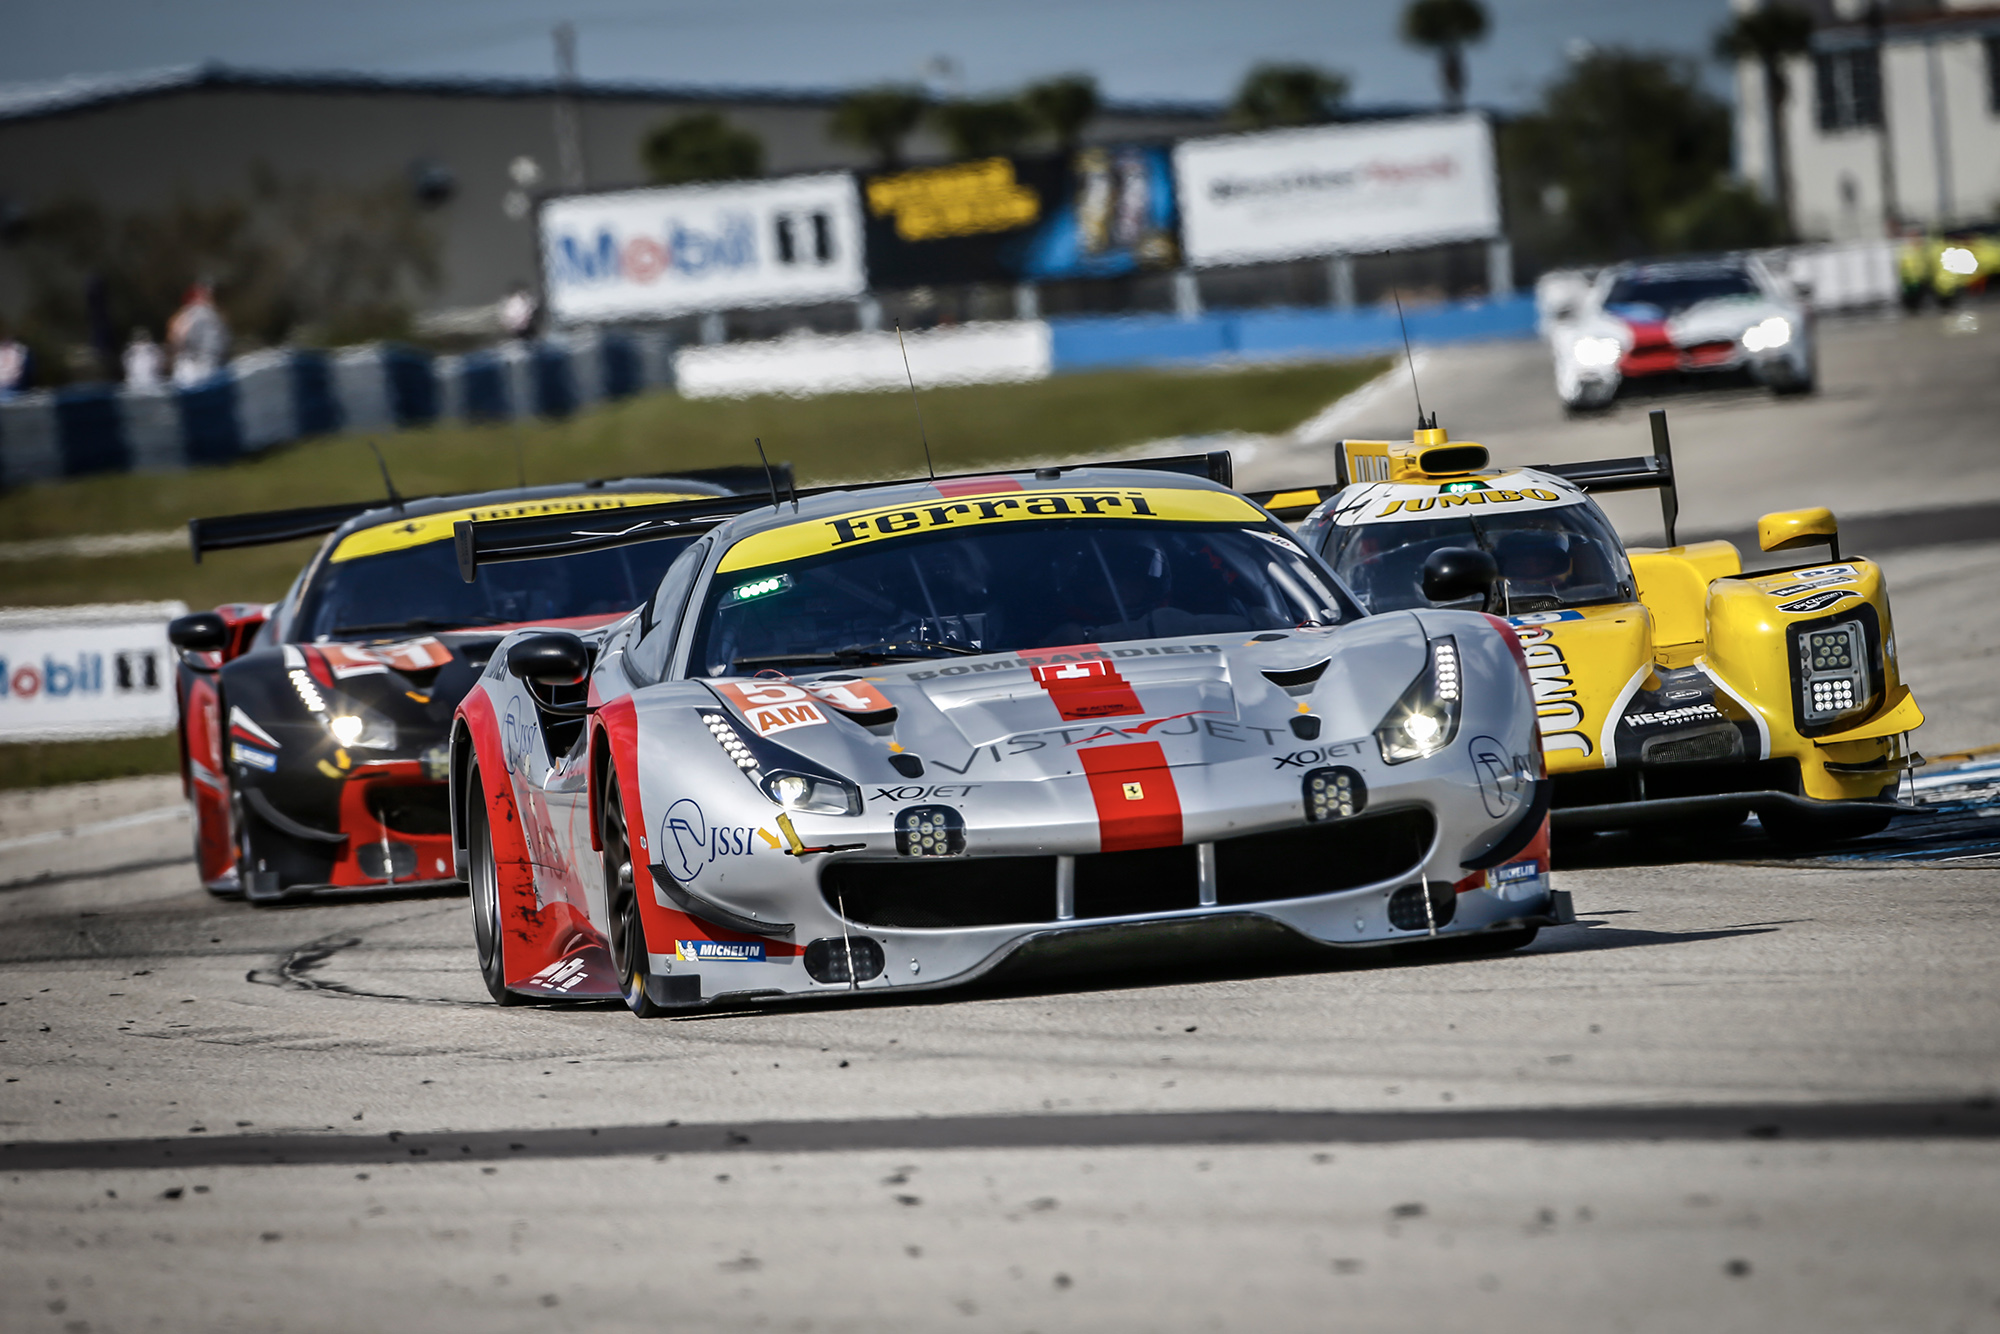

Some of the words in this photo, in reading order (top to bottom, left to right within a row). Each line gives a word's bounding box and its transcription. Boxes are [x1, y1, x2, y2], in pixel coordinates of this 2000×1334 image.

[1376, 488, 1560, 518] JUMBO
[825, 491, 1158, 546] Ferrari
[906, 644, 1223, 682] BOMBARDIER
[734, 681, 872, 710] 54
[1514, 627, 1593, 757] JUMBO
[757, 705, 819, 732] AM
[1624, 703, 1718, 727] HESSING
[1272, 740, 1366, 770] XOJET
[868, 784, 982, 801] XOJET
[708, 826, 756, 863] JSSI
[700, 944, 760, 956] MICHELIN
